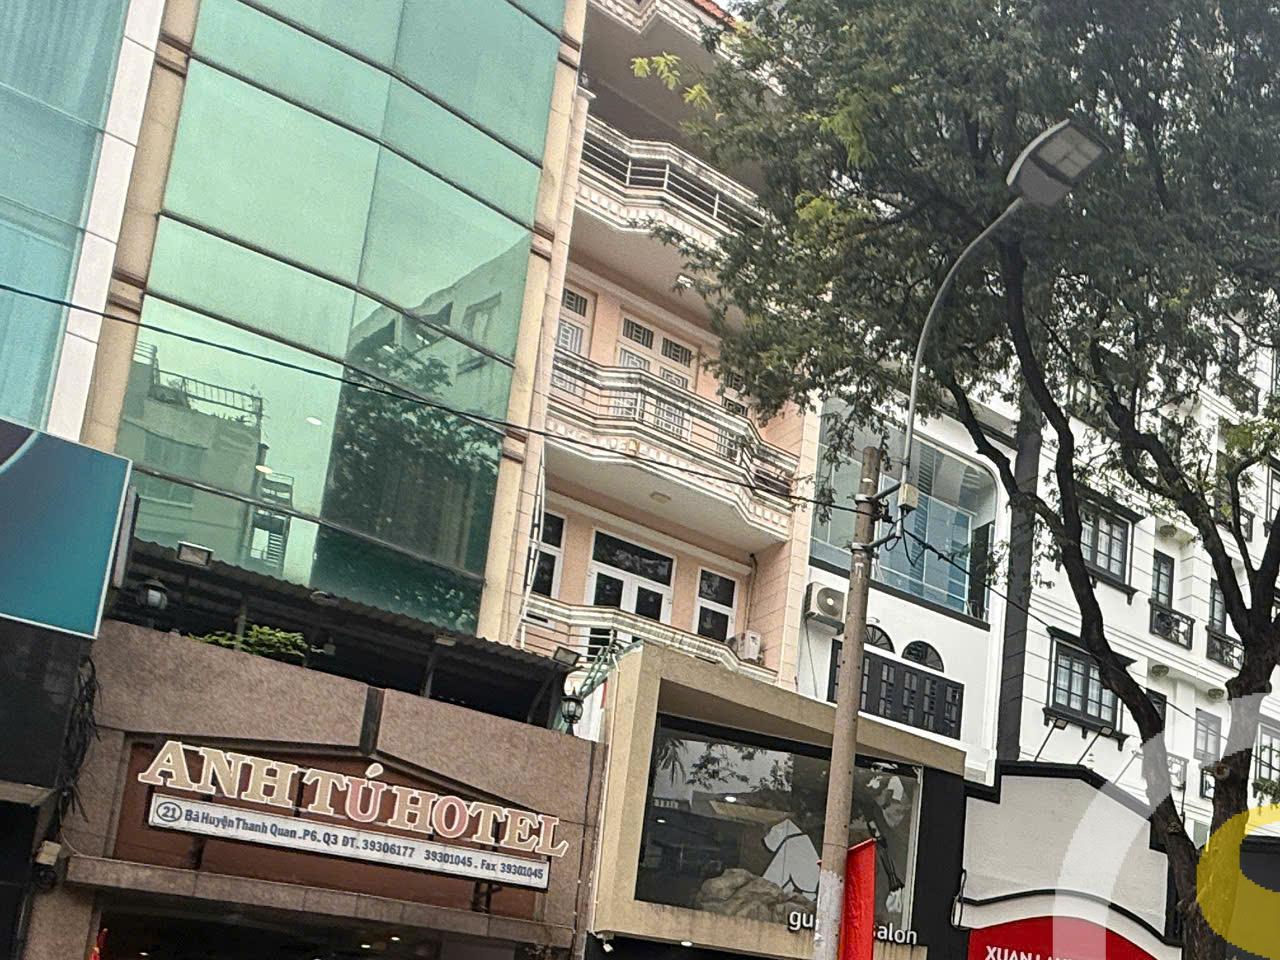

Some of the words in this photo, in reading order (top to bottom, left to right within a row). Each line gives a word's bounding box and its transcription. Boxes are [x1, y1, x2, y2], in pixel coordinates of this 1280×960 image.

[138, 740, 299, 808] ANH
[302, 762, 387, 823] TÚ
[387, 785, 570, 858] HOTEL
[161, 805, 177, 819] 21
[234, 817, 269, 834] Thanh
[362, 838, 416, 859] 39306177
[480, 859, 497, 872] Fax
[873, 922, 918, 945] alon
